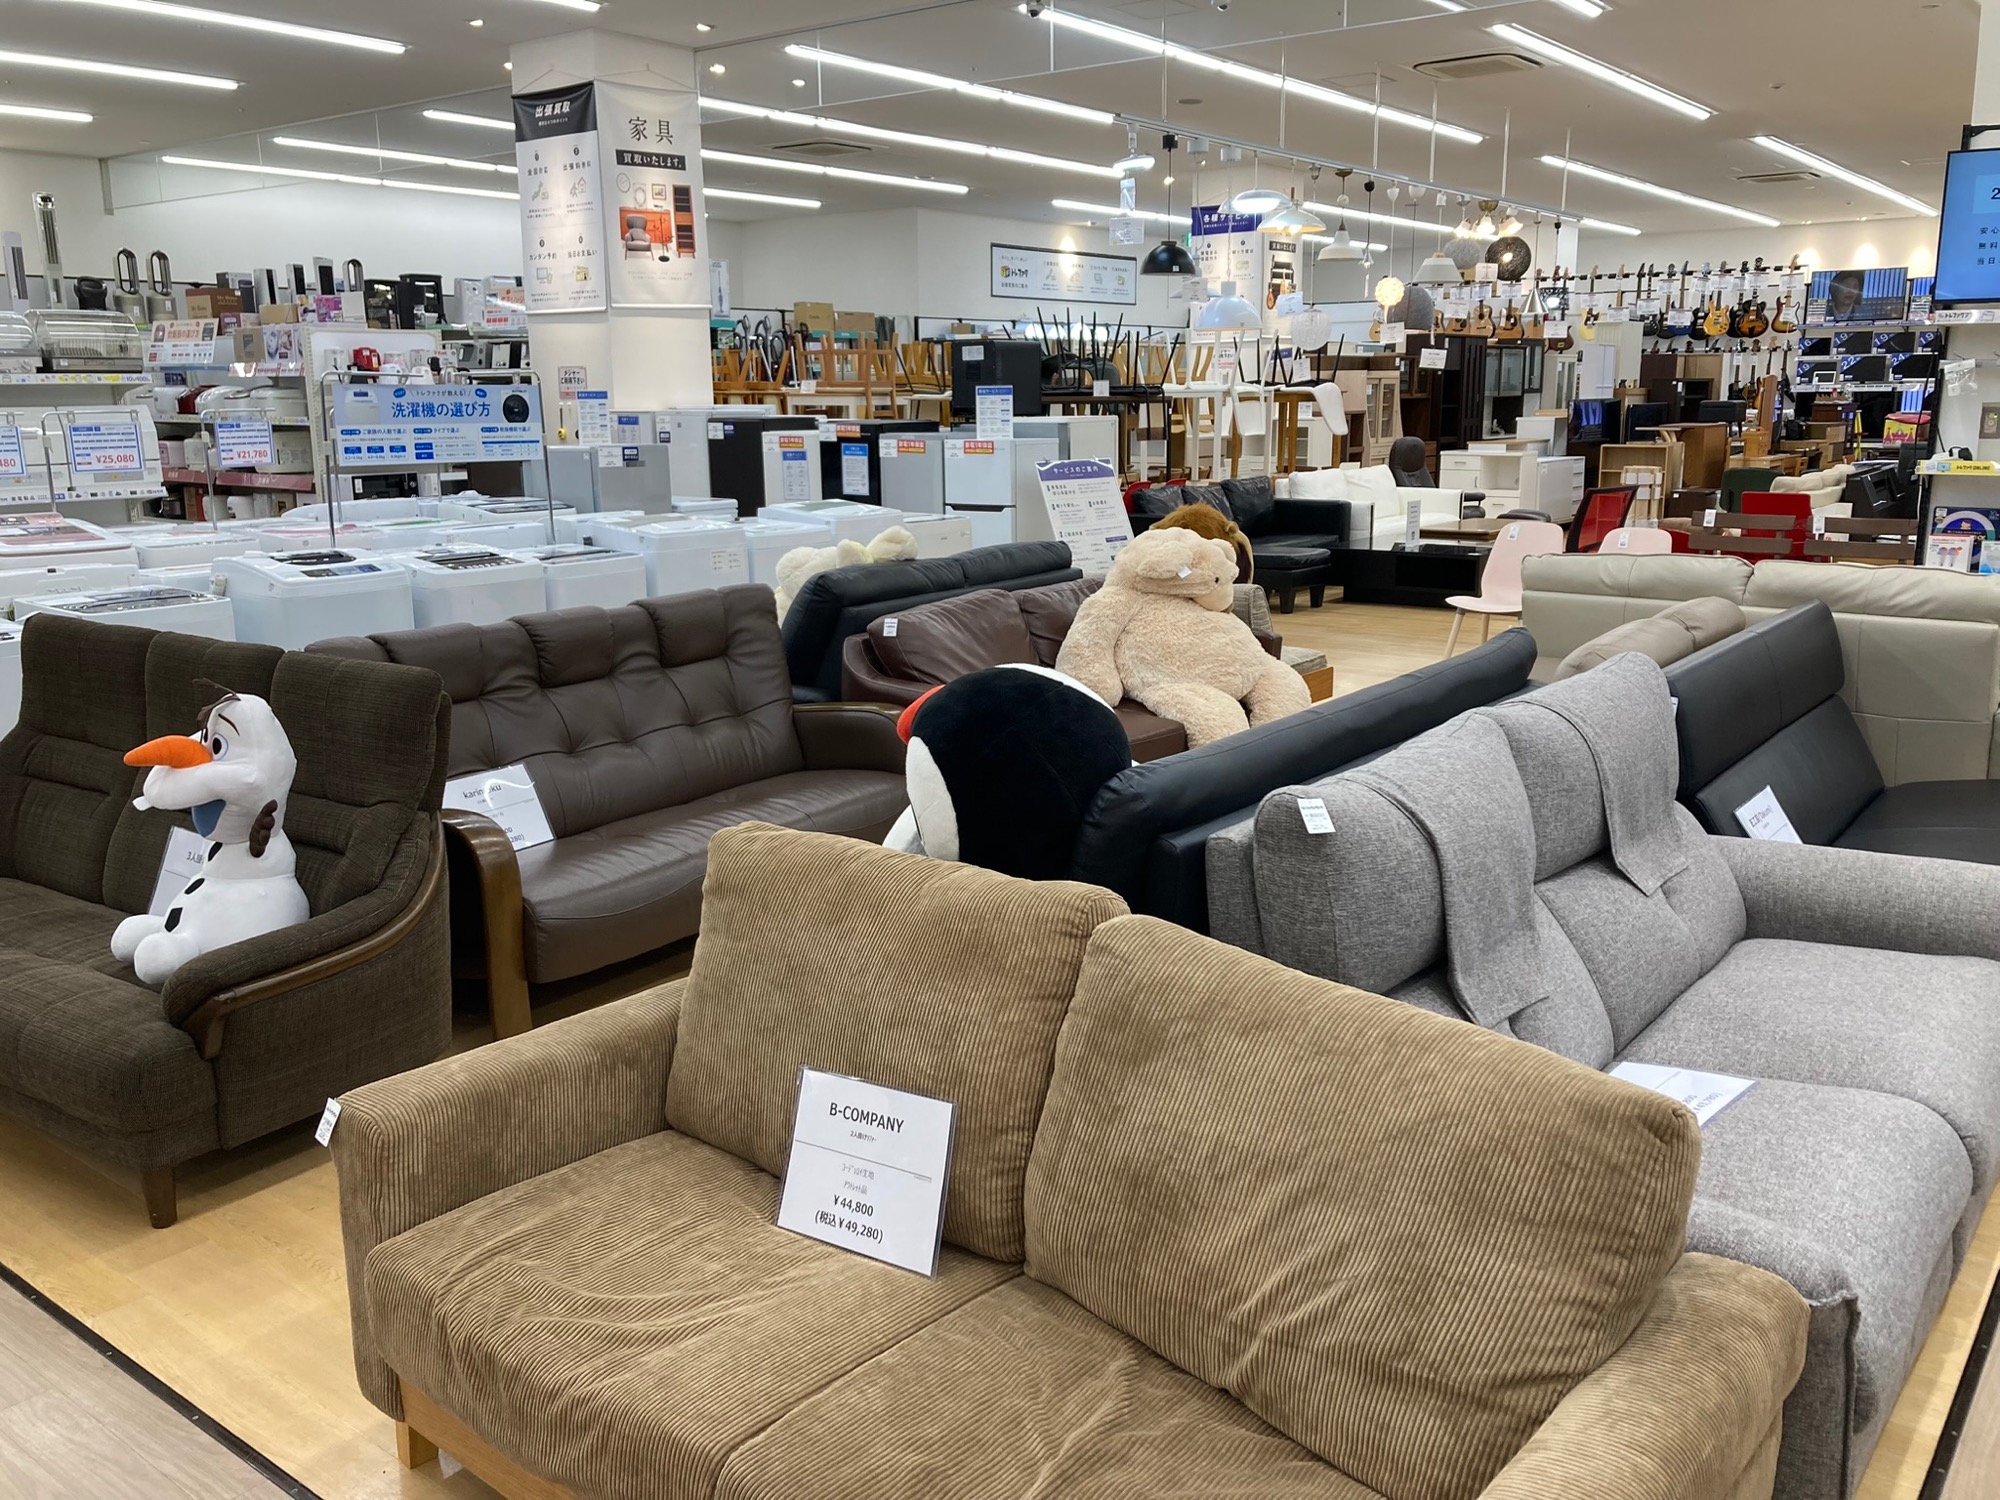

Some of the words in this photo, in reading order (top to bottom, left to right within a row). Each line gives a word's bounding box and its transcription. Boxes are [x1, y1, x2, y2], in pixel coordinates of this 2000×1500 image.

[535, 101, 570, 118] 出張買取
[629, 116, 673, 145] 家具
[623, 152, 682, 168] 買取いたします。
[1977, 257, 2000, 265] 当日
[391, 401, 491, 418] 洗濯機の選び方
[96, 453, 135, 464] ¥25,080
[236, 449, 268, 459] ¥21,780
[1053, 465, 1099, 474] サービスのご案内
[829, 1101, 905, 1134] B-COMPANY
[834, 1194, 874, 1217] ¥44,800
[814, 1209, 884, 1244] (税込¥49,280)
